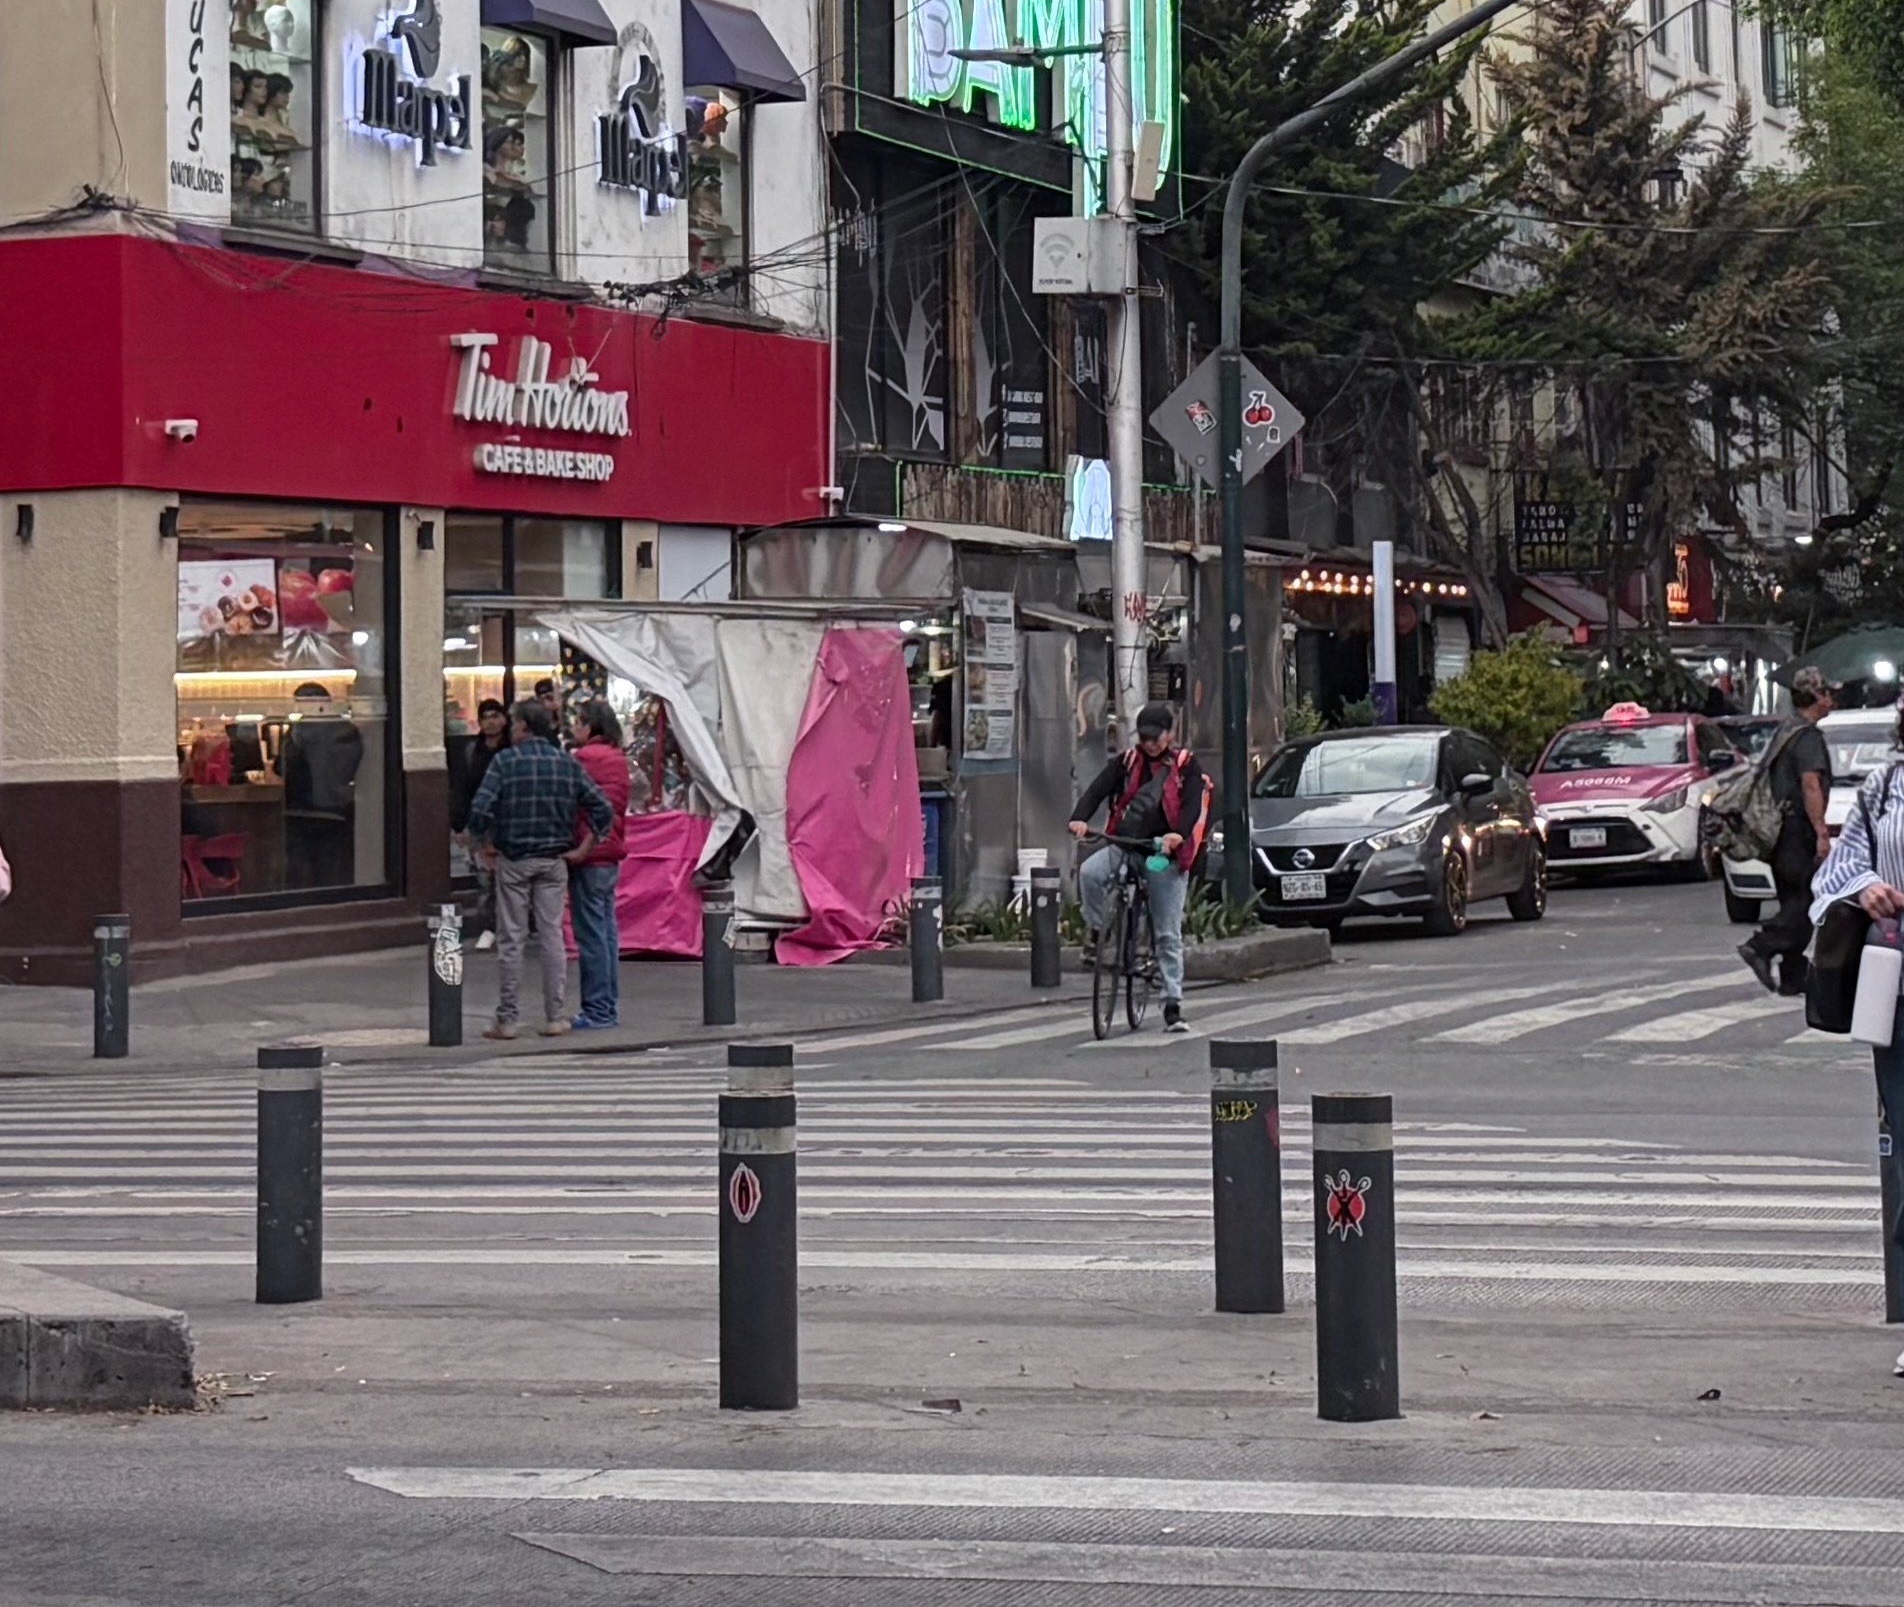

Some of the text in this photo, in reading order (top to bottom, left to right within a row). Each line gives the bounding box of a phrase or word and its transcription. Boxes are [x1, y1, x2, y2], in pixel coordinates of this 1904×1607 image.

[450, 333, 516, 427] Tim
[535, 448, 575, 478] BAKE
[575, 451, 615, 482] SHOP
